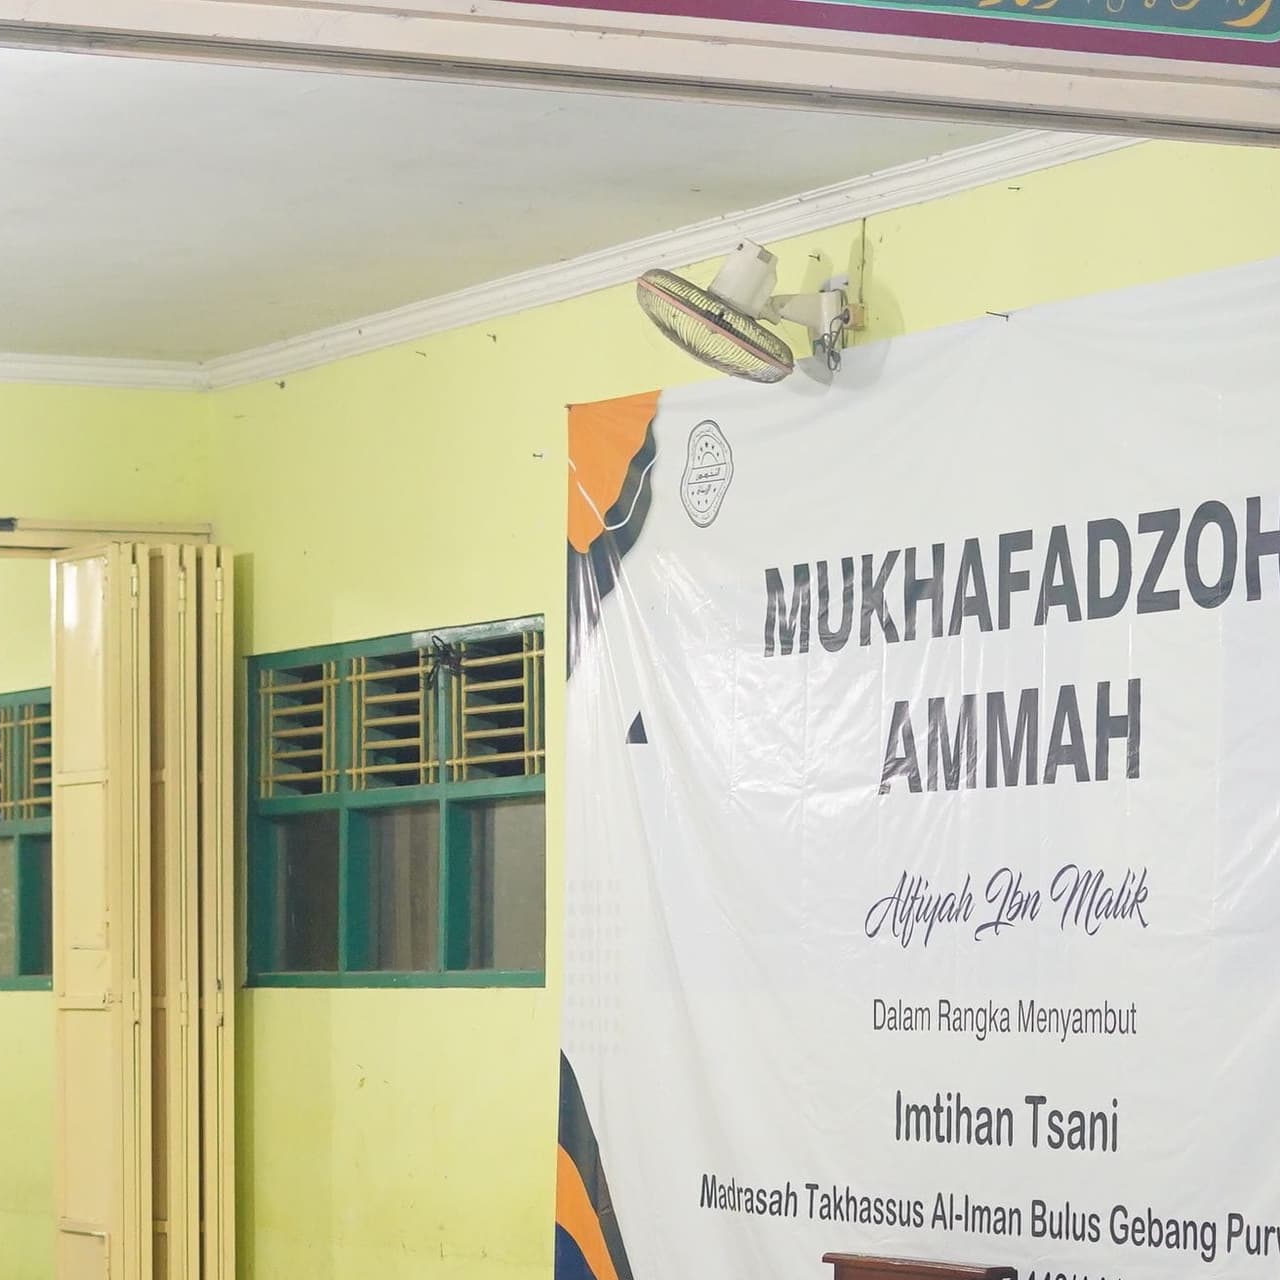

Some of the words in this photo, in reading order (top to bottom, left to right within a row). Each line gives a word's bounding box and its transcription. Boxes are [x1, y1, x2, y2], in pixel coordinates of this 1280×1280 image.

[878, 677, 1143, 797] AMMAH
[865, 870, 973, 948] Alfiyah
[975, 866, 1042, 942] Ibn
[1050, 863, 1151, 932] Malik
[872, 998, 931, 1033] Dalam
[937, 998, 1012, 1043] Rangka
[1017, 999, 1139, 1044] Menyambut
[895, 1088, 1014, 1148] Imtihan
[1024, 1094, 1119, 1153] Tsani
[699, 1172, 799, 1219] Madrasah
[805, 1182, 926, 1230] Takhassus
[930, 1191, 1022, 1238] Al-Iman
[1030, 1198, 1102, 1247] Bulus
[1108, 1203, 1217, 1263] Gebang
